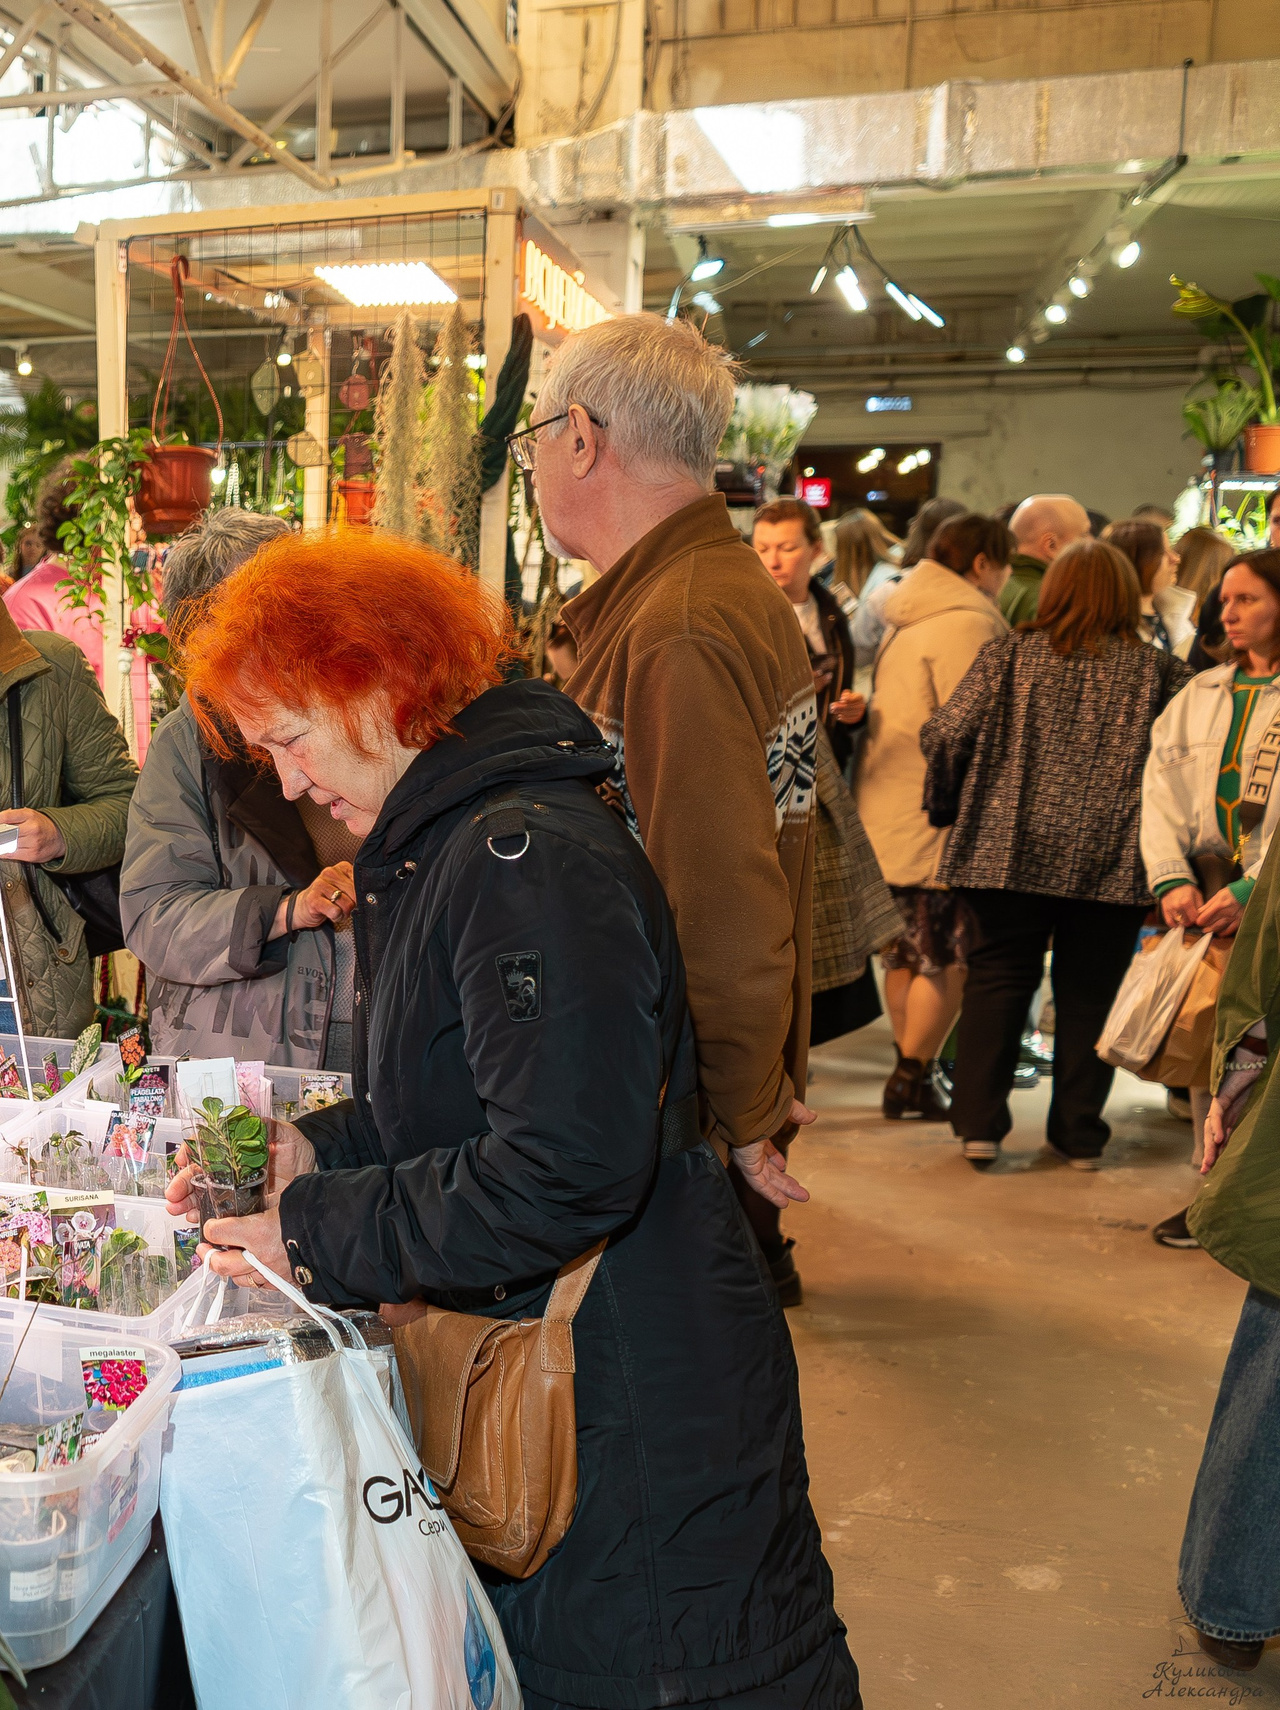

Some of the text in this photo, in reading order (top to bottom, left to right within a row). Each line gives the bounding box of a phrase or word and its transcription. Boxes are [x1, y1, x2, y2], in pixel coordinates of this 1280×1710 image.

[64, 1193, 100, 1203] SURISANA
[89, 1350, 137, 1358] megalaster
[418, 1518, 448, 1537] Сери
